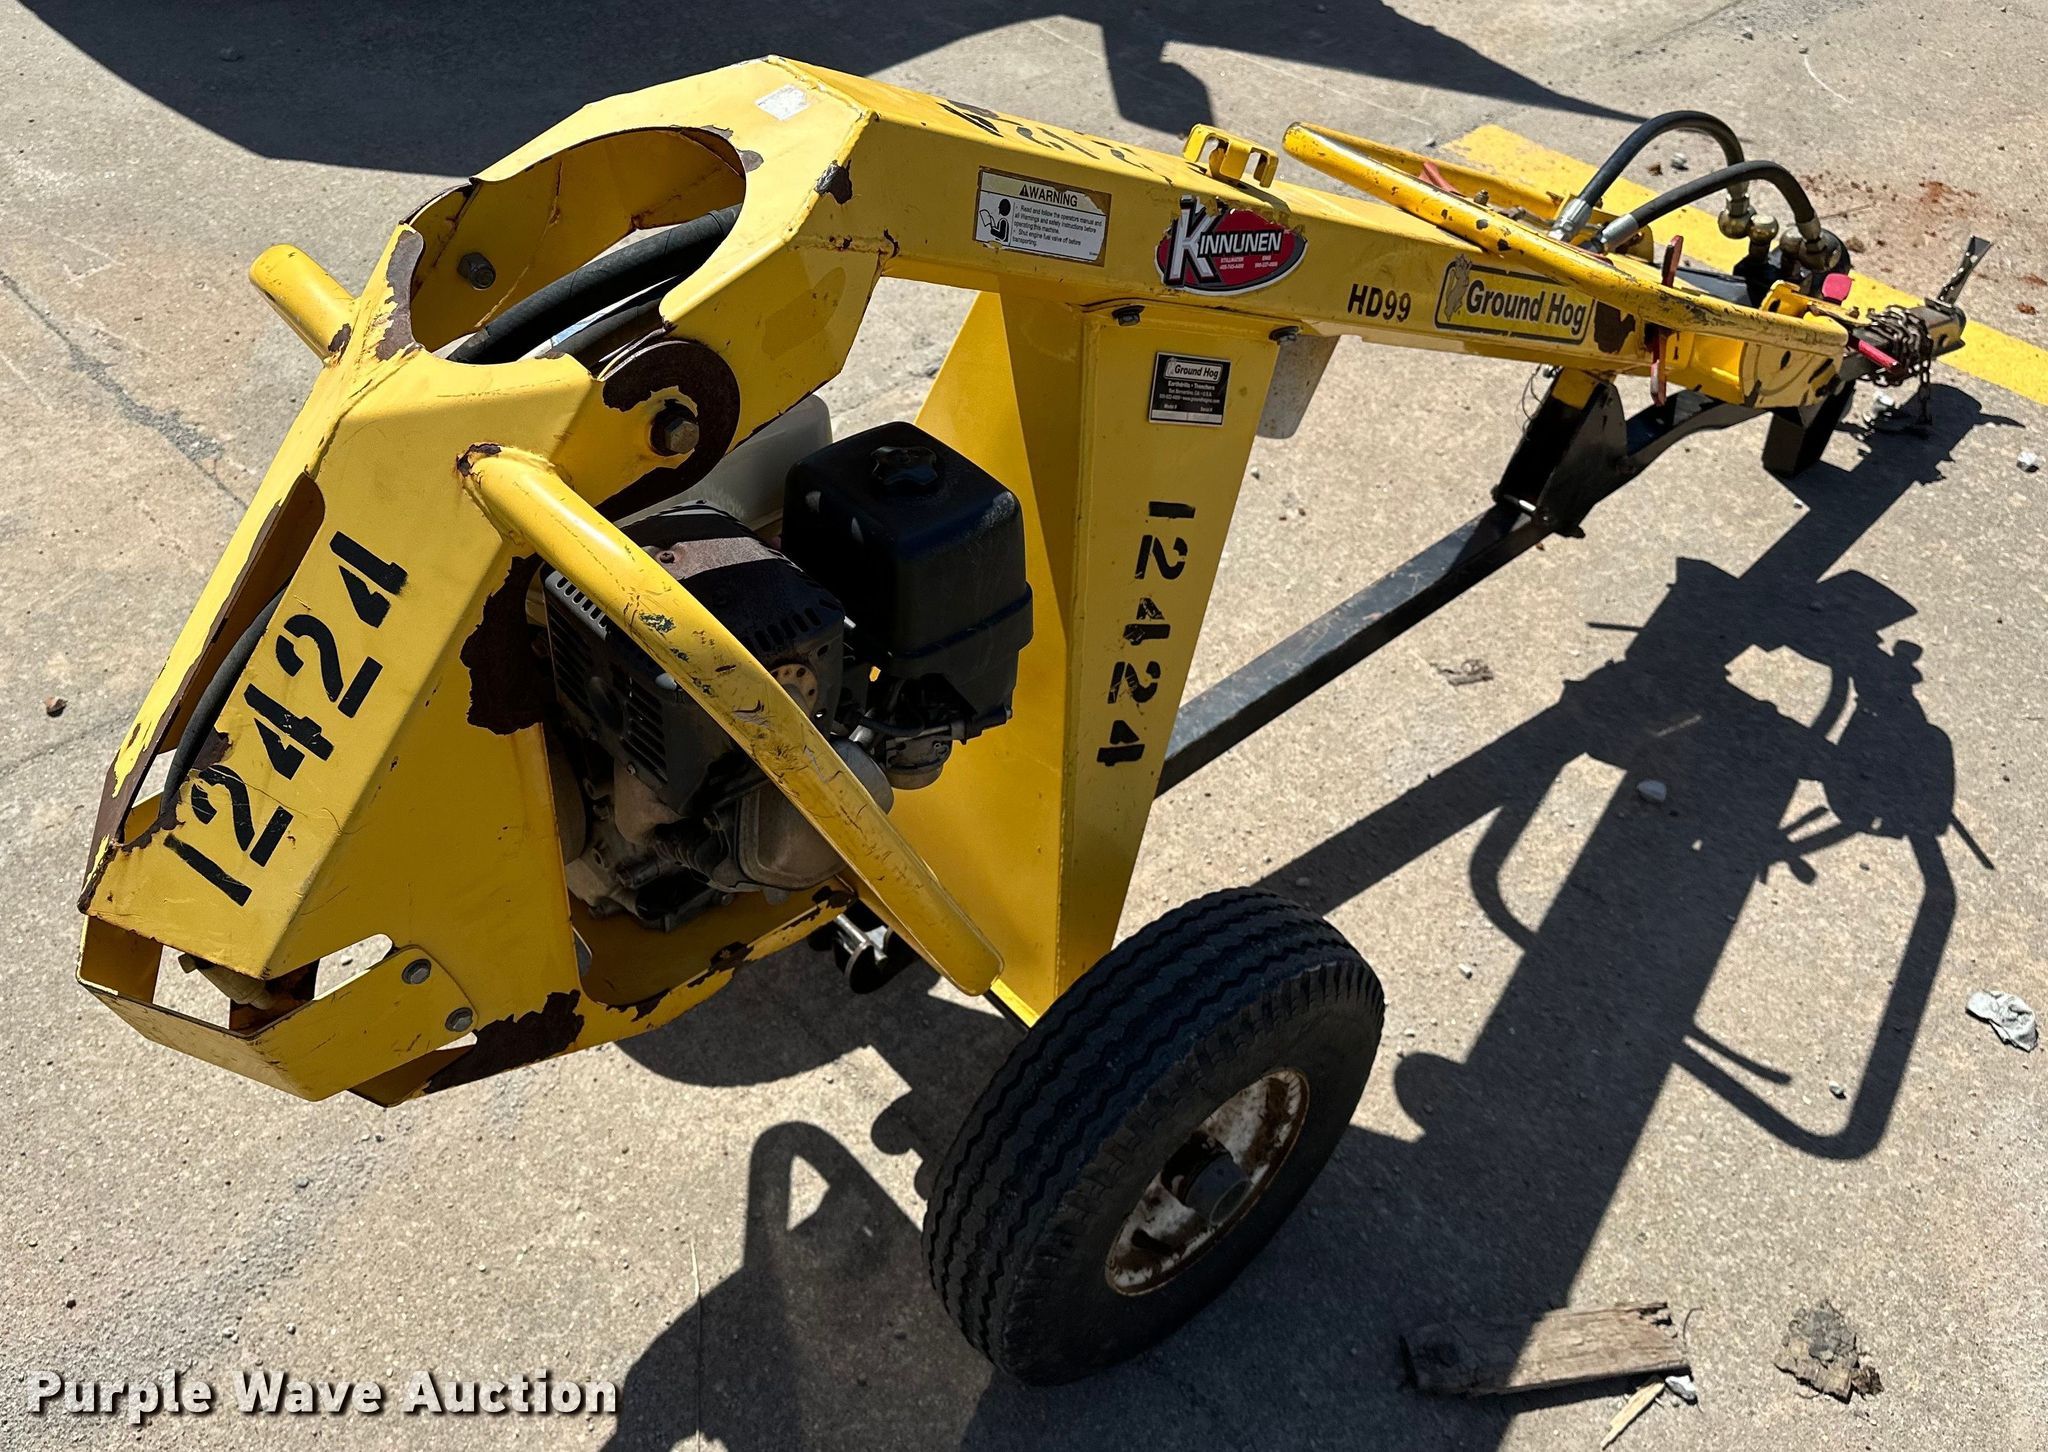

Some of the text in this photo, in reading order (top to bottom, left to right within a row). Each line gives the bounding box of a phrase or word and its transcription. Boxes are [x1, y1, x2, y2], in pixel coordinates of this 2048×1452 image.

[1021, 205, 1032, 213] Read
[1042, 208, 1052, 217] follow
[1029, 186, 1078, 207] WARNING
[1014, 221, 1033, 230] operating
[1049, 218, 1060, 227] safety
[1169, 194, 1283, 283] KINNUNEN
[1347, 283, 1411, 323] HD99
[1466, 279, 1586, 336] Ground Hog
[1174, 364, 1219, 380] Ground Hog
[1097, 501, 1196, 766] 12424
[163, 530, 409, 906] 12424
